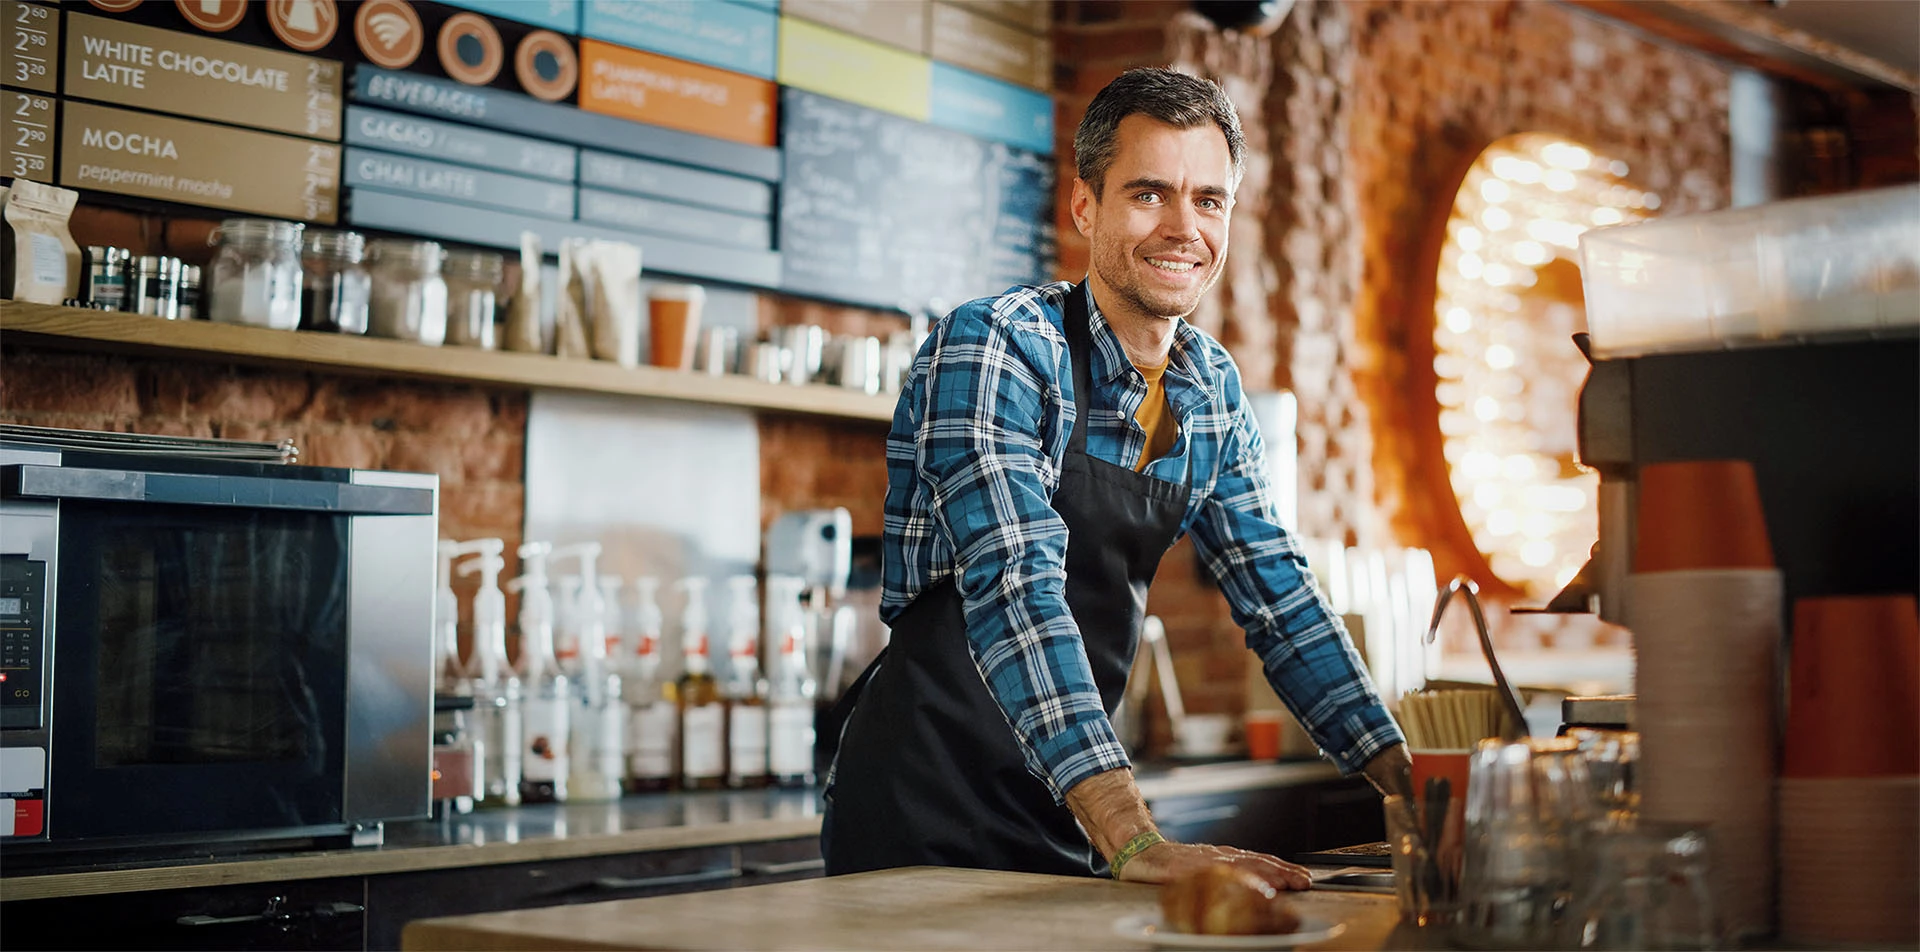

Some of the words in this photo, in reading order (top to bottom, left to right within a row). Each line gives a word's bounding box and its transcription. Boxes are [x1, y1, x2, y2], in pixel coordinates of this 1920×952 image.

[82, 60, 145, 89] LATTE
[83, 35, 153, 66] WHITE
[157, 50, 289, 92] CHOCOLATE
[368, 74, 487, 118] BEVERAGES
[82, 127, 179, 160] MOCHA
[360, 116, 435, 148] CACAO
[78, 164, 175, 191] peppermint
[176, 177, 234, 199] mocha
[359, 158, 415, 187] CHAI
[417, 168, 477, 197] LATTE
